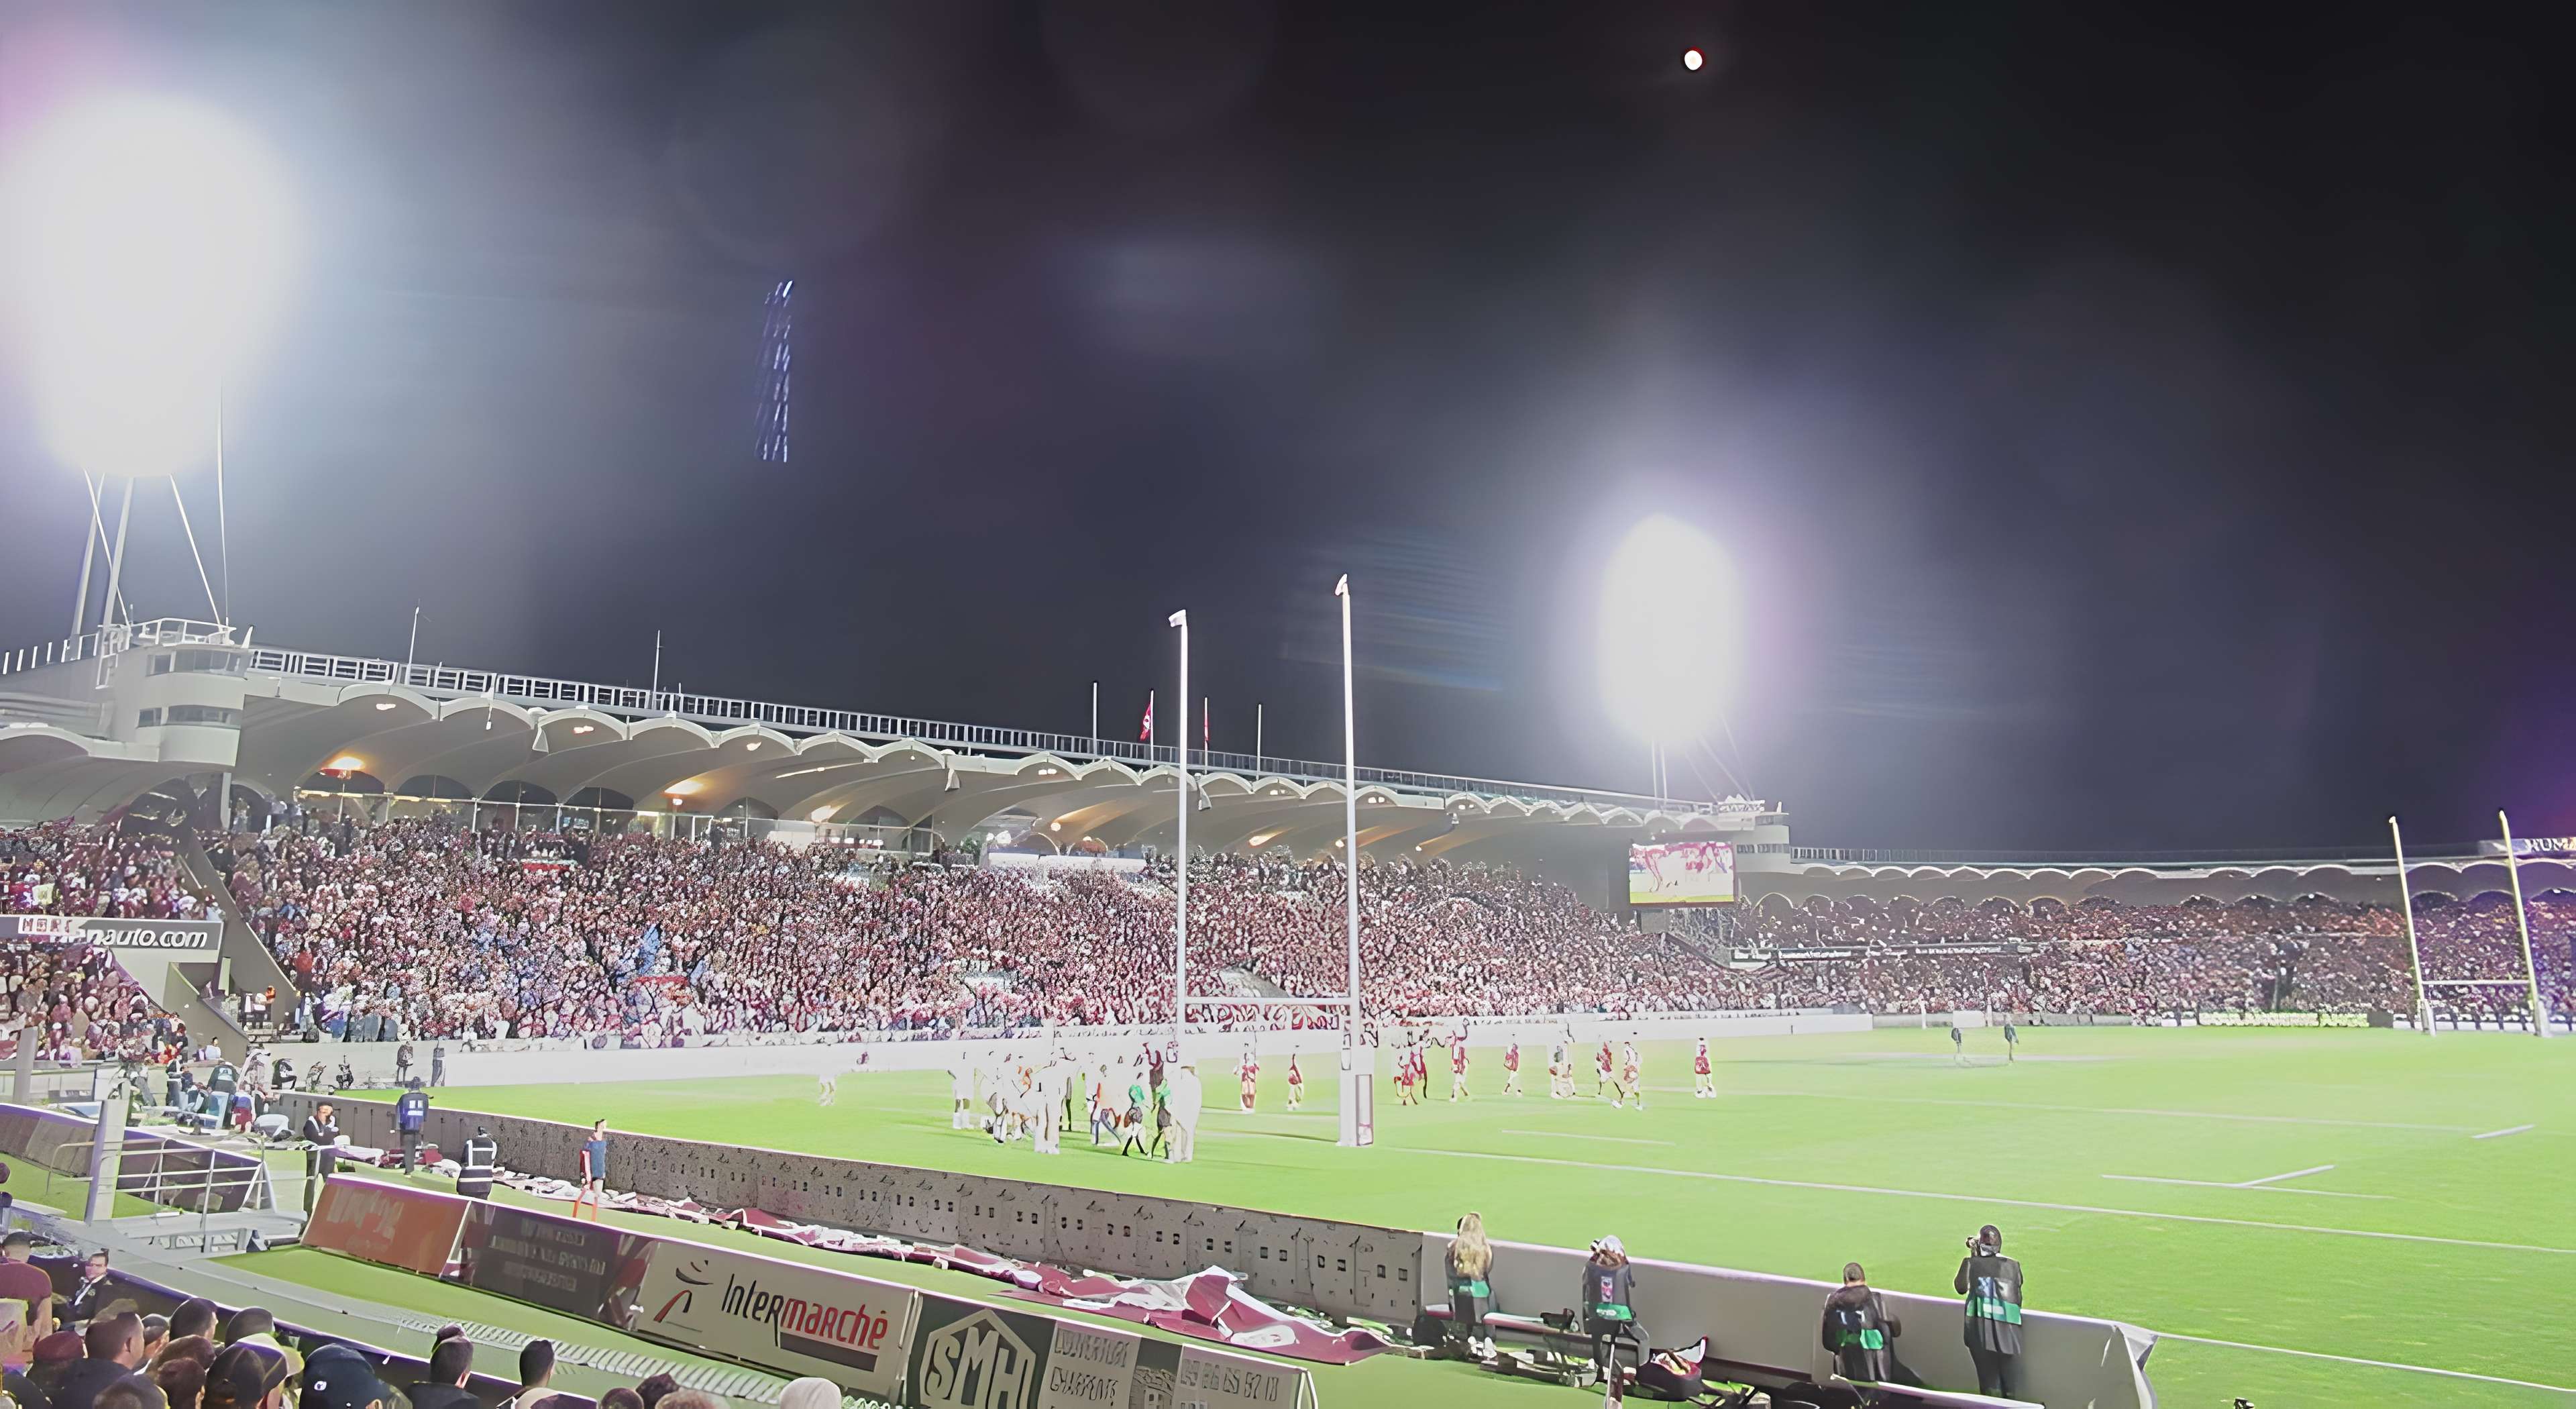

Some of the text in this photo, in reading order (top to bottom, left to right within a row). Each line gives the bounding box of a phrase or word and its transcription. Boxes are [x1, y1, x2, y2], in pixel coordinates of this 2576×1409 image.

[83, 927, 208, 948] nauto.com
[721, 1273, 888, 1351] Intermarché
[924, 1326, 1036, 1409] SMH
